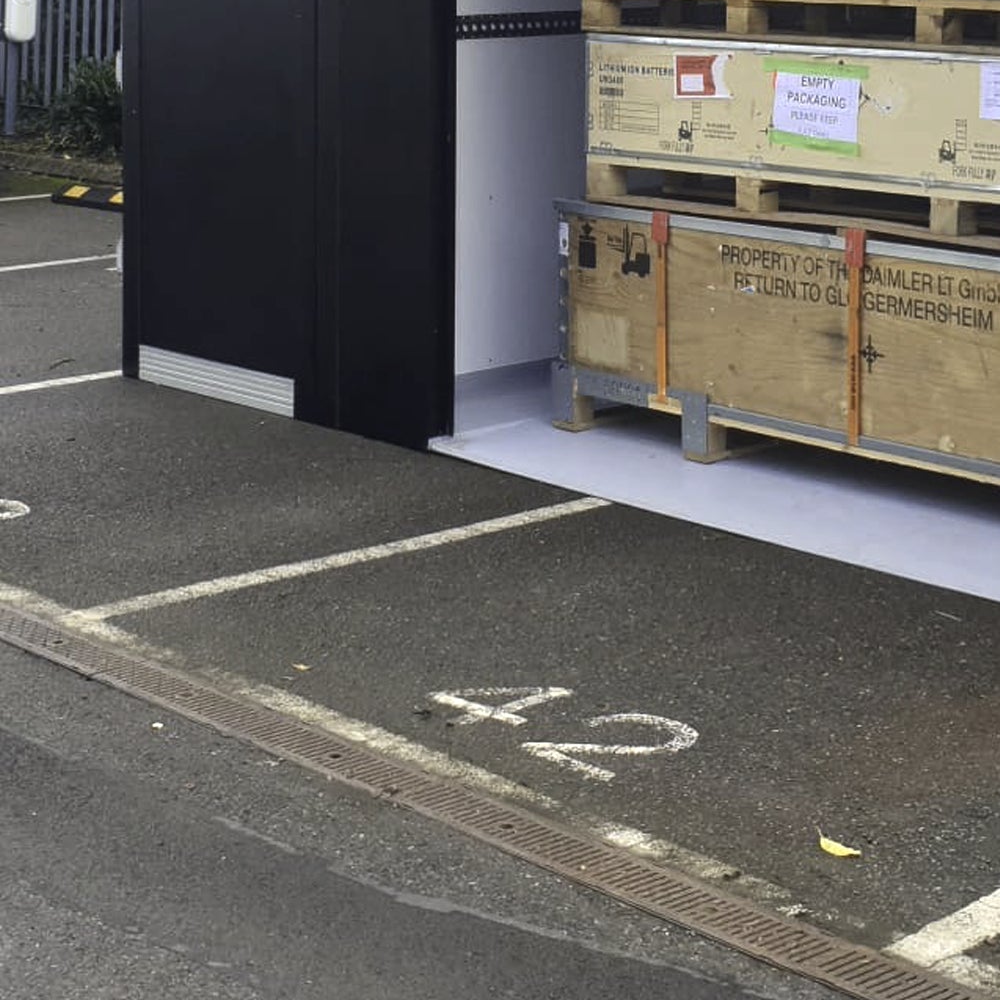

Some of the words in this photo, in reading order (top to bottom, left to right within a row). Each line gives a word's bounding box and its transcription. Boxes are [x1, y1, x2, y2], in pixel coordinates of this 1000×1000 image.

[641, 66, 674, 77] BATTERIE
[801, 75, 835, 90] EMPTY
[787, 91, 847, 110] PACKAGING
[721, 244, 800, 273] PROPERTY
[803, 256, 823, 276] OF
[828, 259, 848, 281] TH
[863, 264, 933, 294] DAIMLER
[937, 275, 955, 297] LT
[734, 271, 797, 299] RETURN
[799, 282, 821, 303] TO
[862, 291, 994, 331] GERMERSHEIM
